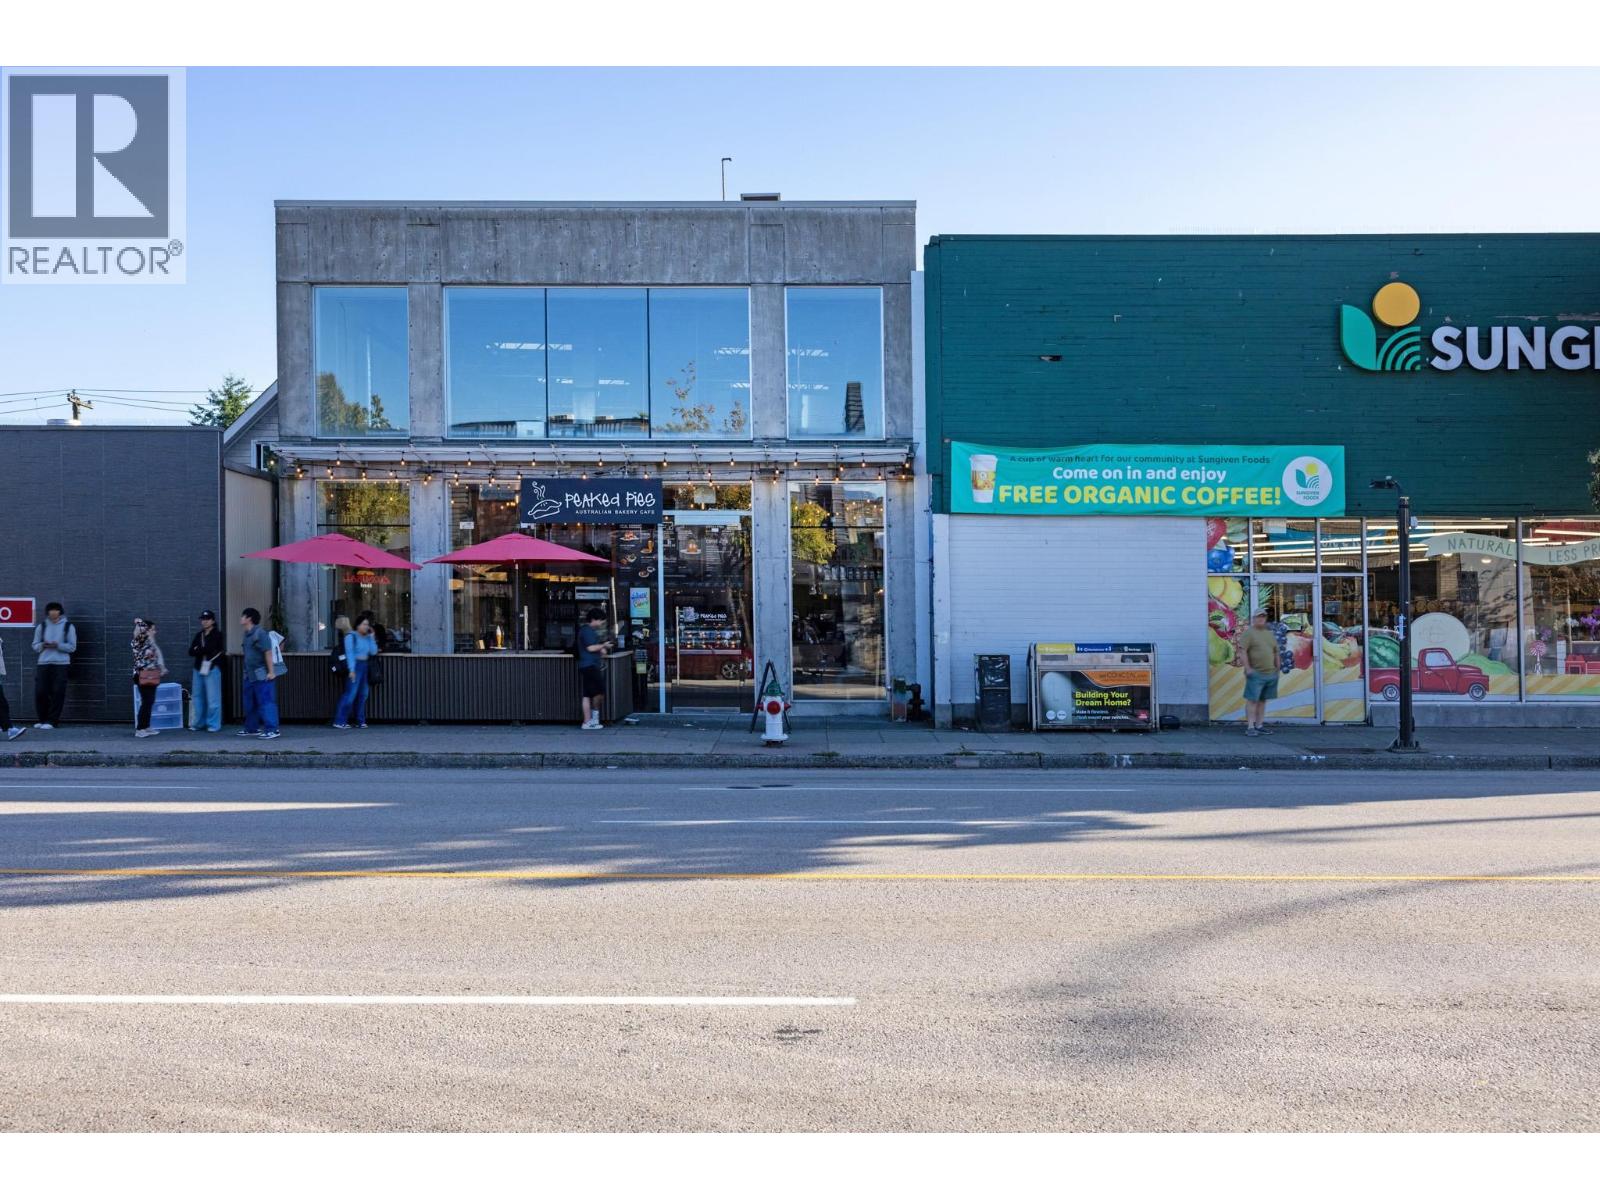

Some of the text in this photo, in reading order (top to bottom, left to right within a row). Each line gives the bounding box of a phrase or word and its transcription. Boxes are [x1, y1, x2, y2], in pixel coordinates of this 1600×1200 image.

[1075, 454, 1098, 463] heart
[1101, 455, 1114, 463] for
[1135, 456, 1184, 465] community
[1198, 456, 1240, 465] Sungiven
[1242, 456, 1271, 464] Foods
[1052, 465, 1227, 484] Come on in and enjoy
[999, 485, 1281, 505] FREE ORGANIC COFFEE!
[1447, 538, 1513, 556] NATURAL
[1548, 543, 1600, 562] LESS PR
[1075, 691, 1129, 700] Building Your
